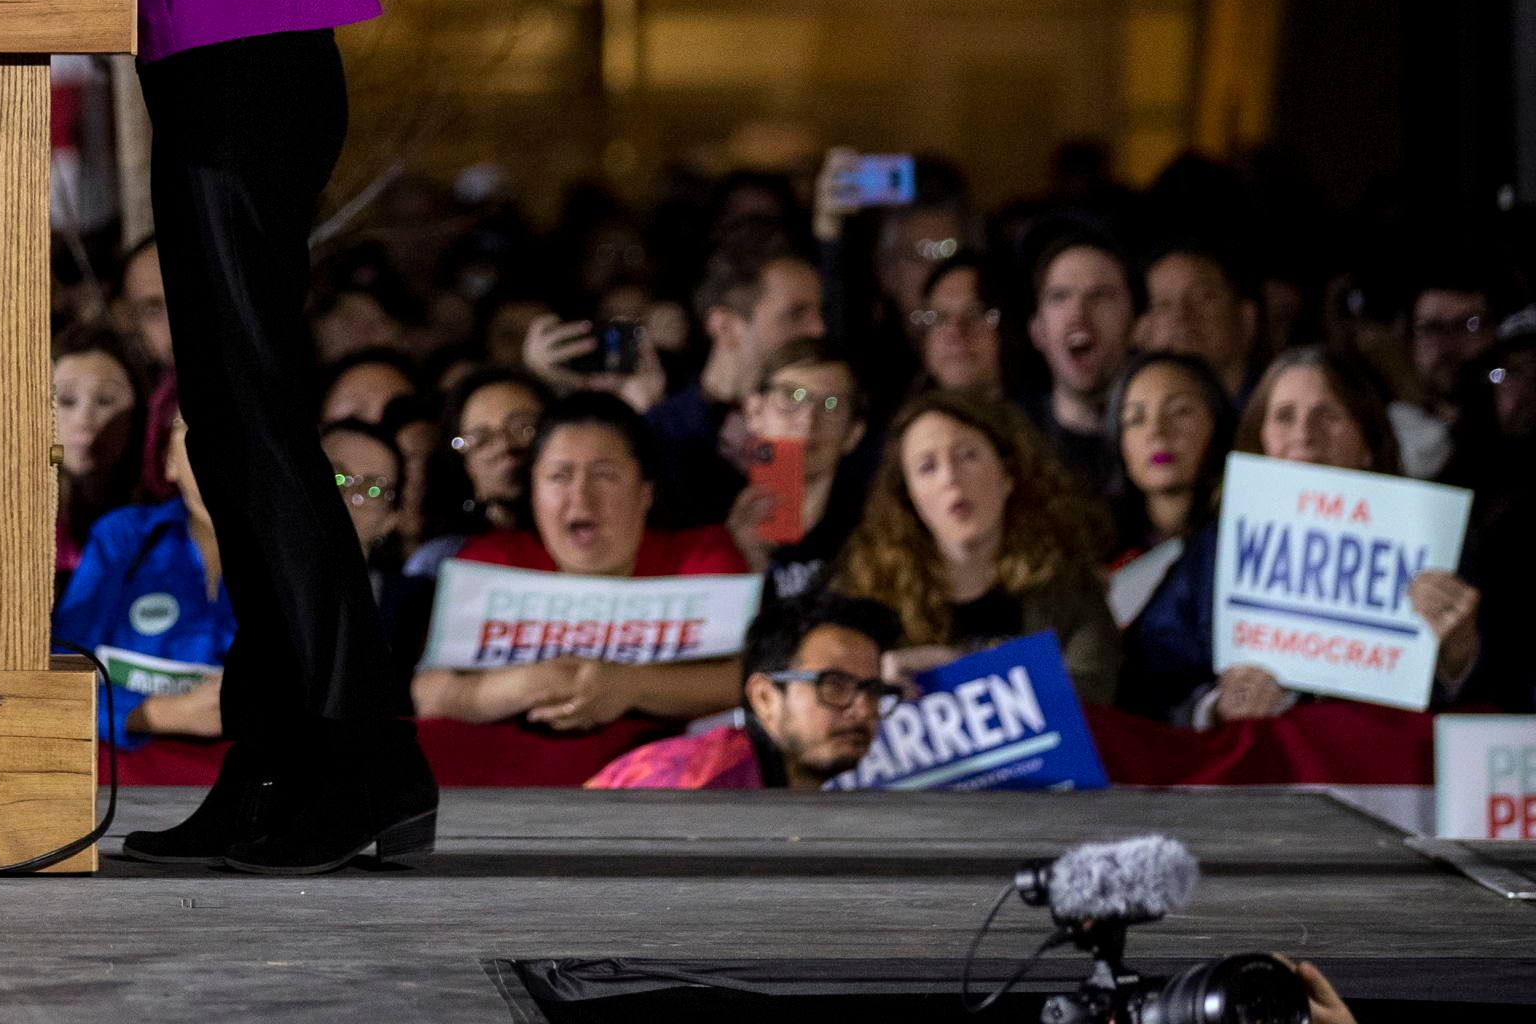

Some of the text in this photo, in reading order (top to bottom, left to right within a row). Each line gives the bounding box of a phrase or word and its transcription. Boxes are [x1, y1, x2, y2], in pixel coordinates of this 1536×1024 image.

[1297, 489, 1373, 523] I'M A
[1234, 518, 1427, 611] WARREN
[1232, 620, 1404, 670] DEMOCRAT
[822, 665, 1047, 790] ARREN
